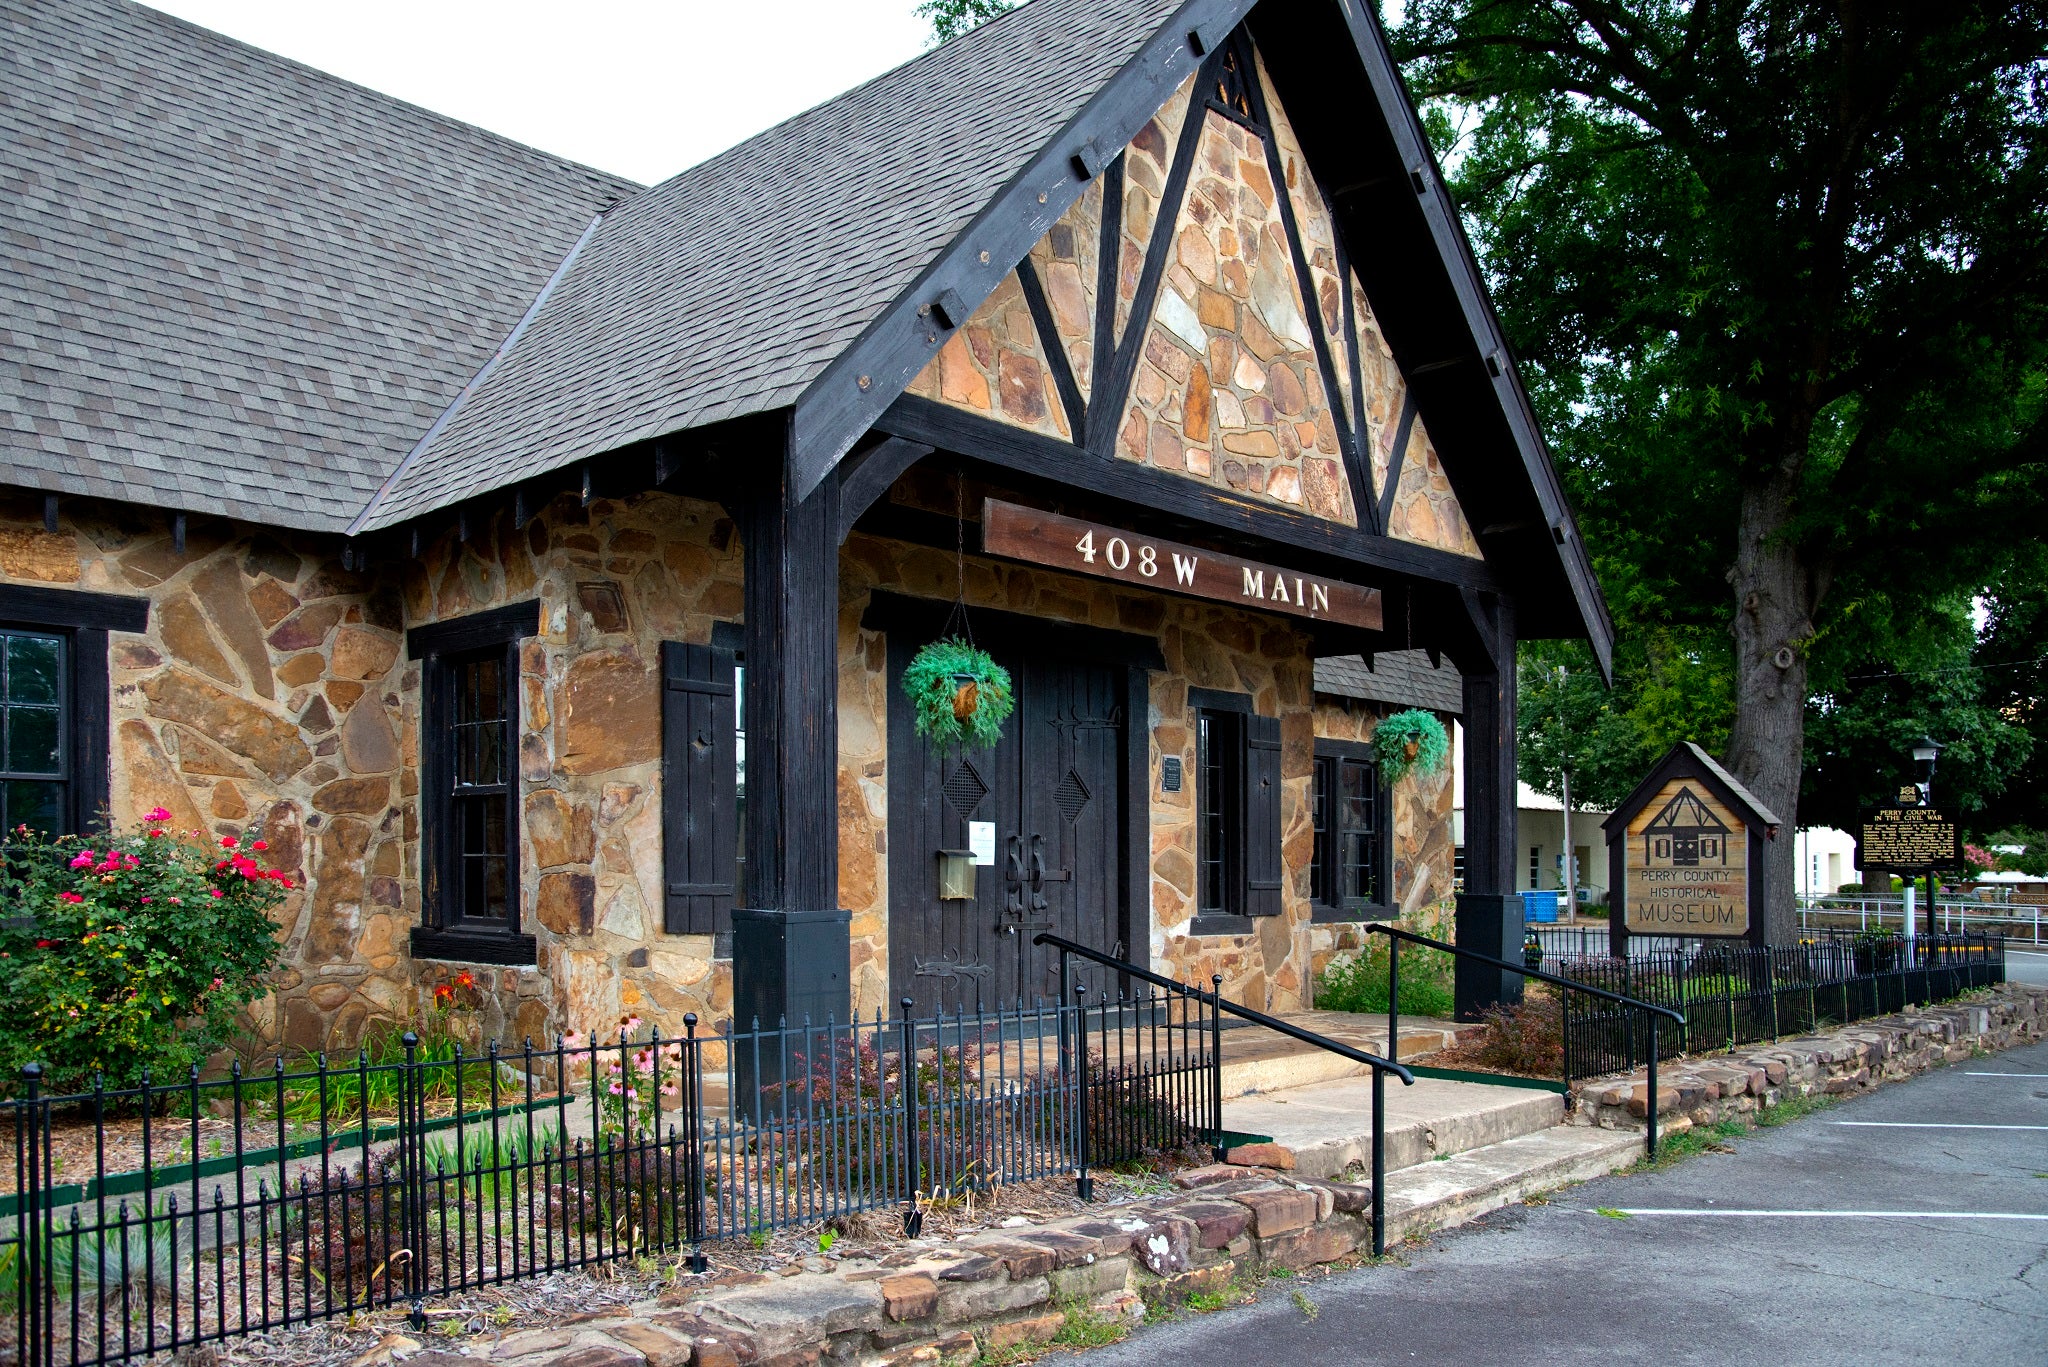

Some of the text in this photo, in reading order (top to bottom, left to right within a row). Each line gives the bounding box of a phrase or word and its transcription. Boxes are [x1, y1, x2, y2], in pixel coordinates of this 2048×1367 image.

[1242, 567, 1330, 614] MAIN
[1641, 871, 1730, 881] PERRY COUNTY
[1650, 888, 1720, 898] HISTORICAL
[1639, 904, 1734, 924] MUSEUM
